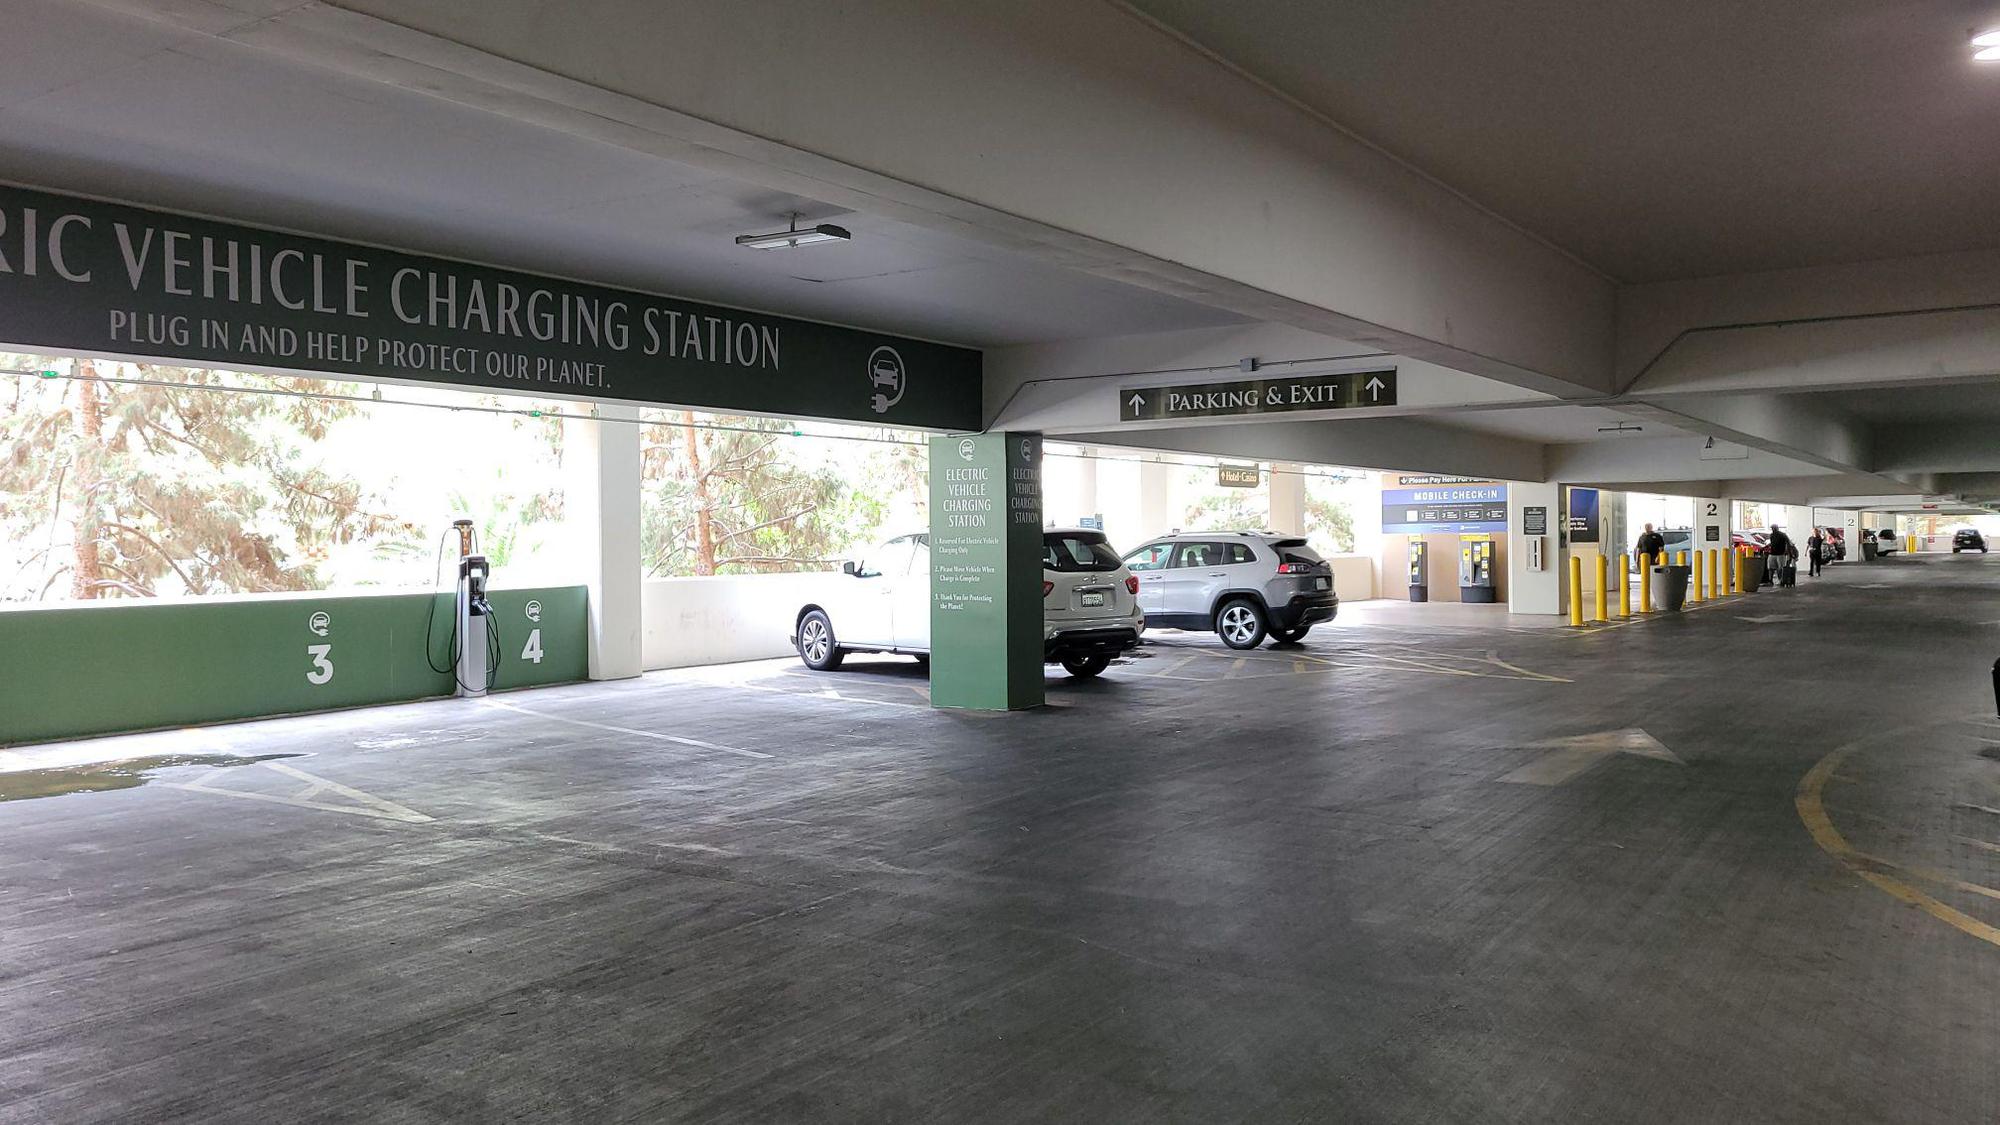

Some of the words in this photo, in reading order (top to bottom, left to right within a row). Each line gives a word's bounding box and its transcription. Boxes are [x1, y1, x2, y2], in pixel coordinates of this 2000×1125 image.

[113, 222, 369, 317] VEHICLE
[390, 267, 630, 351] CHARGING
[642, 307, 780, 371] STATION
[110, 309, 190, 347] PLUG
[201, 319, 229, 352] IN
[239, 323, 298, 357] AND
[307, 331, 369, 364] HELP
[378, 338, 479, 374] PROTECT
[485, 351, 530, 380] OUR
[536, 357, 611, 389] PLANET.
[1168, 389, 1259, 412] PARKING
[1265, 385, 1283, 406] &
[1290, 384, 1338, 404] EXIT
[946, 467, 988, 481] ELECTRIC
[1429, 476, 1441, 484] Pay
[948, 483, 985, 496] VEHICLE
[1014, 483, 1038, 495] VEHICLE
[1414, 491, 1449, 501] MOBILE
[1452, 489, 1498, 500] CHECK-IN
[943, 499, 991, 512] CHARGING
[1707, 503, 1718, 516] 2
[948, 514, 986, 527] STATION
[1015, 512, 1039, 524] STATION
[1847, 518, 1855, 527] 2
[521, 628, 544, 664] 4
[306, 643, 334, 685] 3
